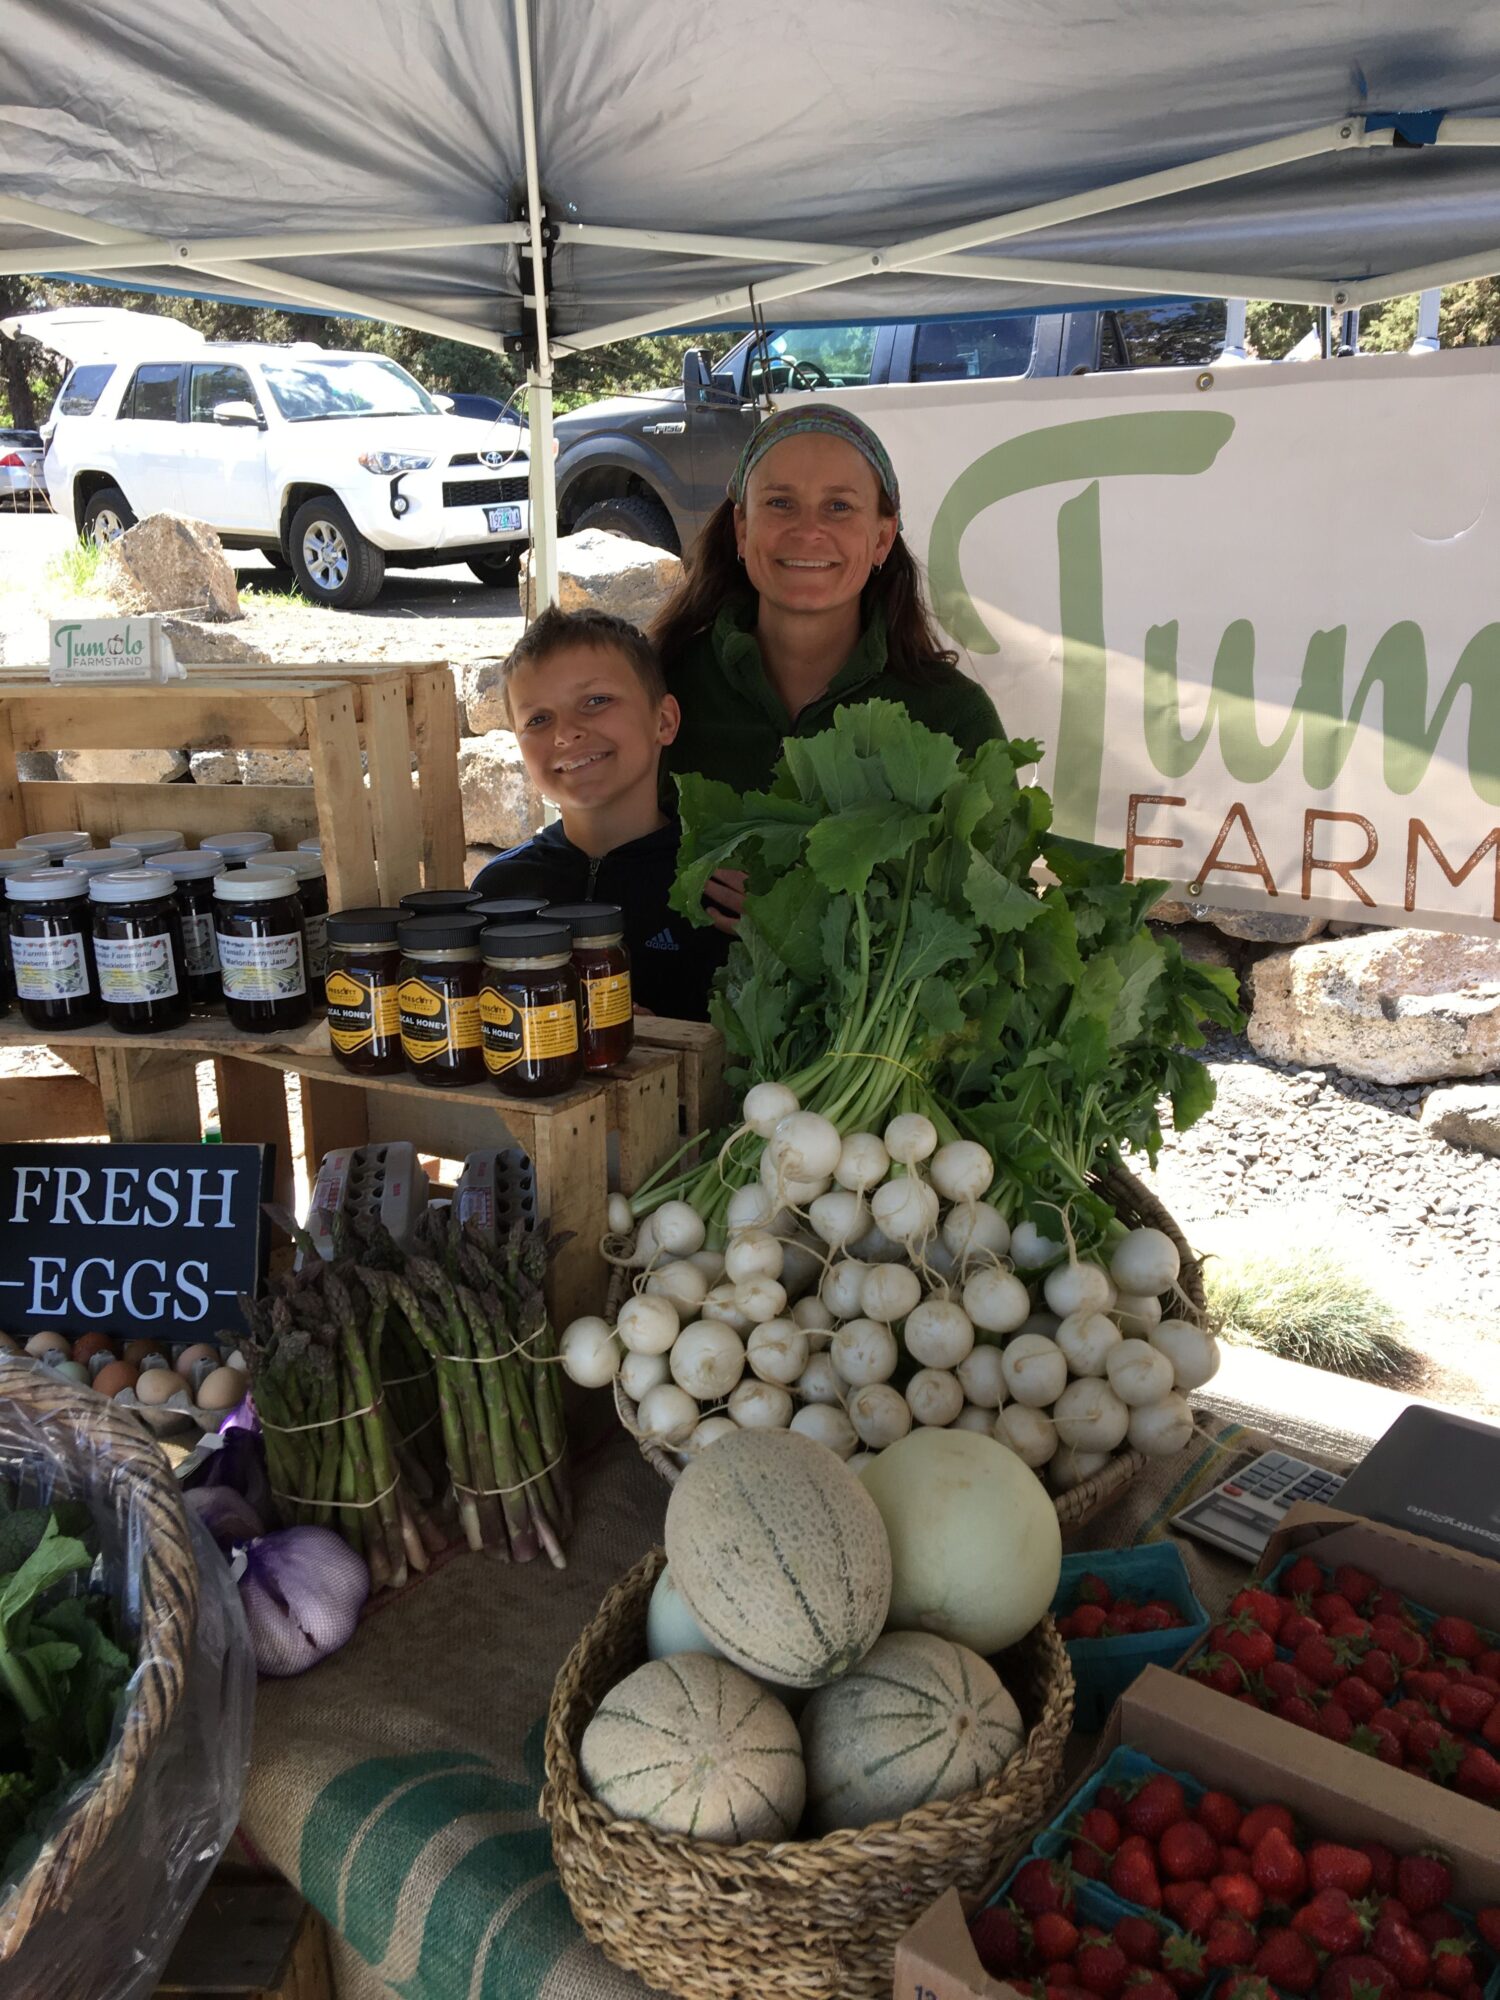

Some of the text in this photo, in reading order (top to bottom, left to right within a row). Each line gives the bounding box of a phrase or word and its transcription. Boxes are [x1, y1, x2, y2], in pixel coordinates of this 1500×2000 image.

[928, 410, 1500, 844] Tum
[73, 656, 143, 667] FARMSTAND
[1125, 793, 1500, 923] FARM
[645, 940, 679, 950] adidas
[22, 949, 62, 957] Farmstand
[112, 949, 151, 959] Farmstand
[247, 946, 289, 957] Farmstand
[140, 959, 157, 968] Jam
[270, 957, 288, 965] Jam
[343, 1009, 372, 1020] HONEY
[416, 1018, 447, 1030] HONEY
[492, 1025, 520, 1041] HONEY
[8, 1166, 239, 1228] FRESH
[25, 1256, 210, 1322] EGGS
